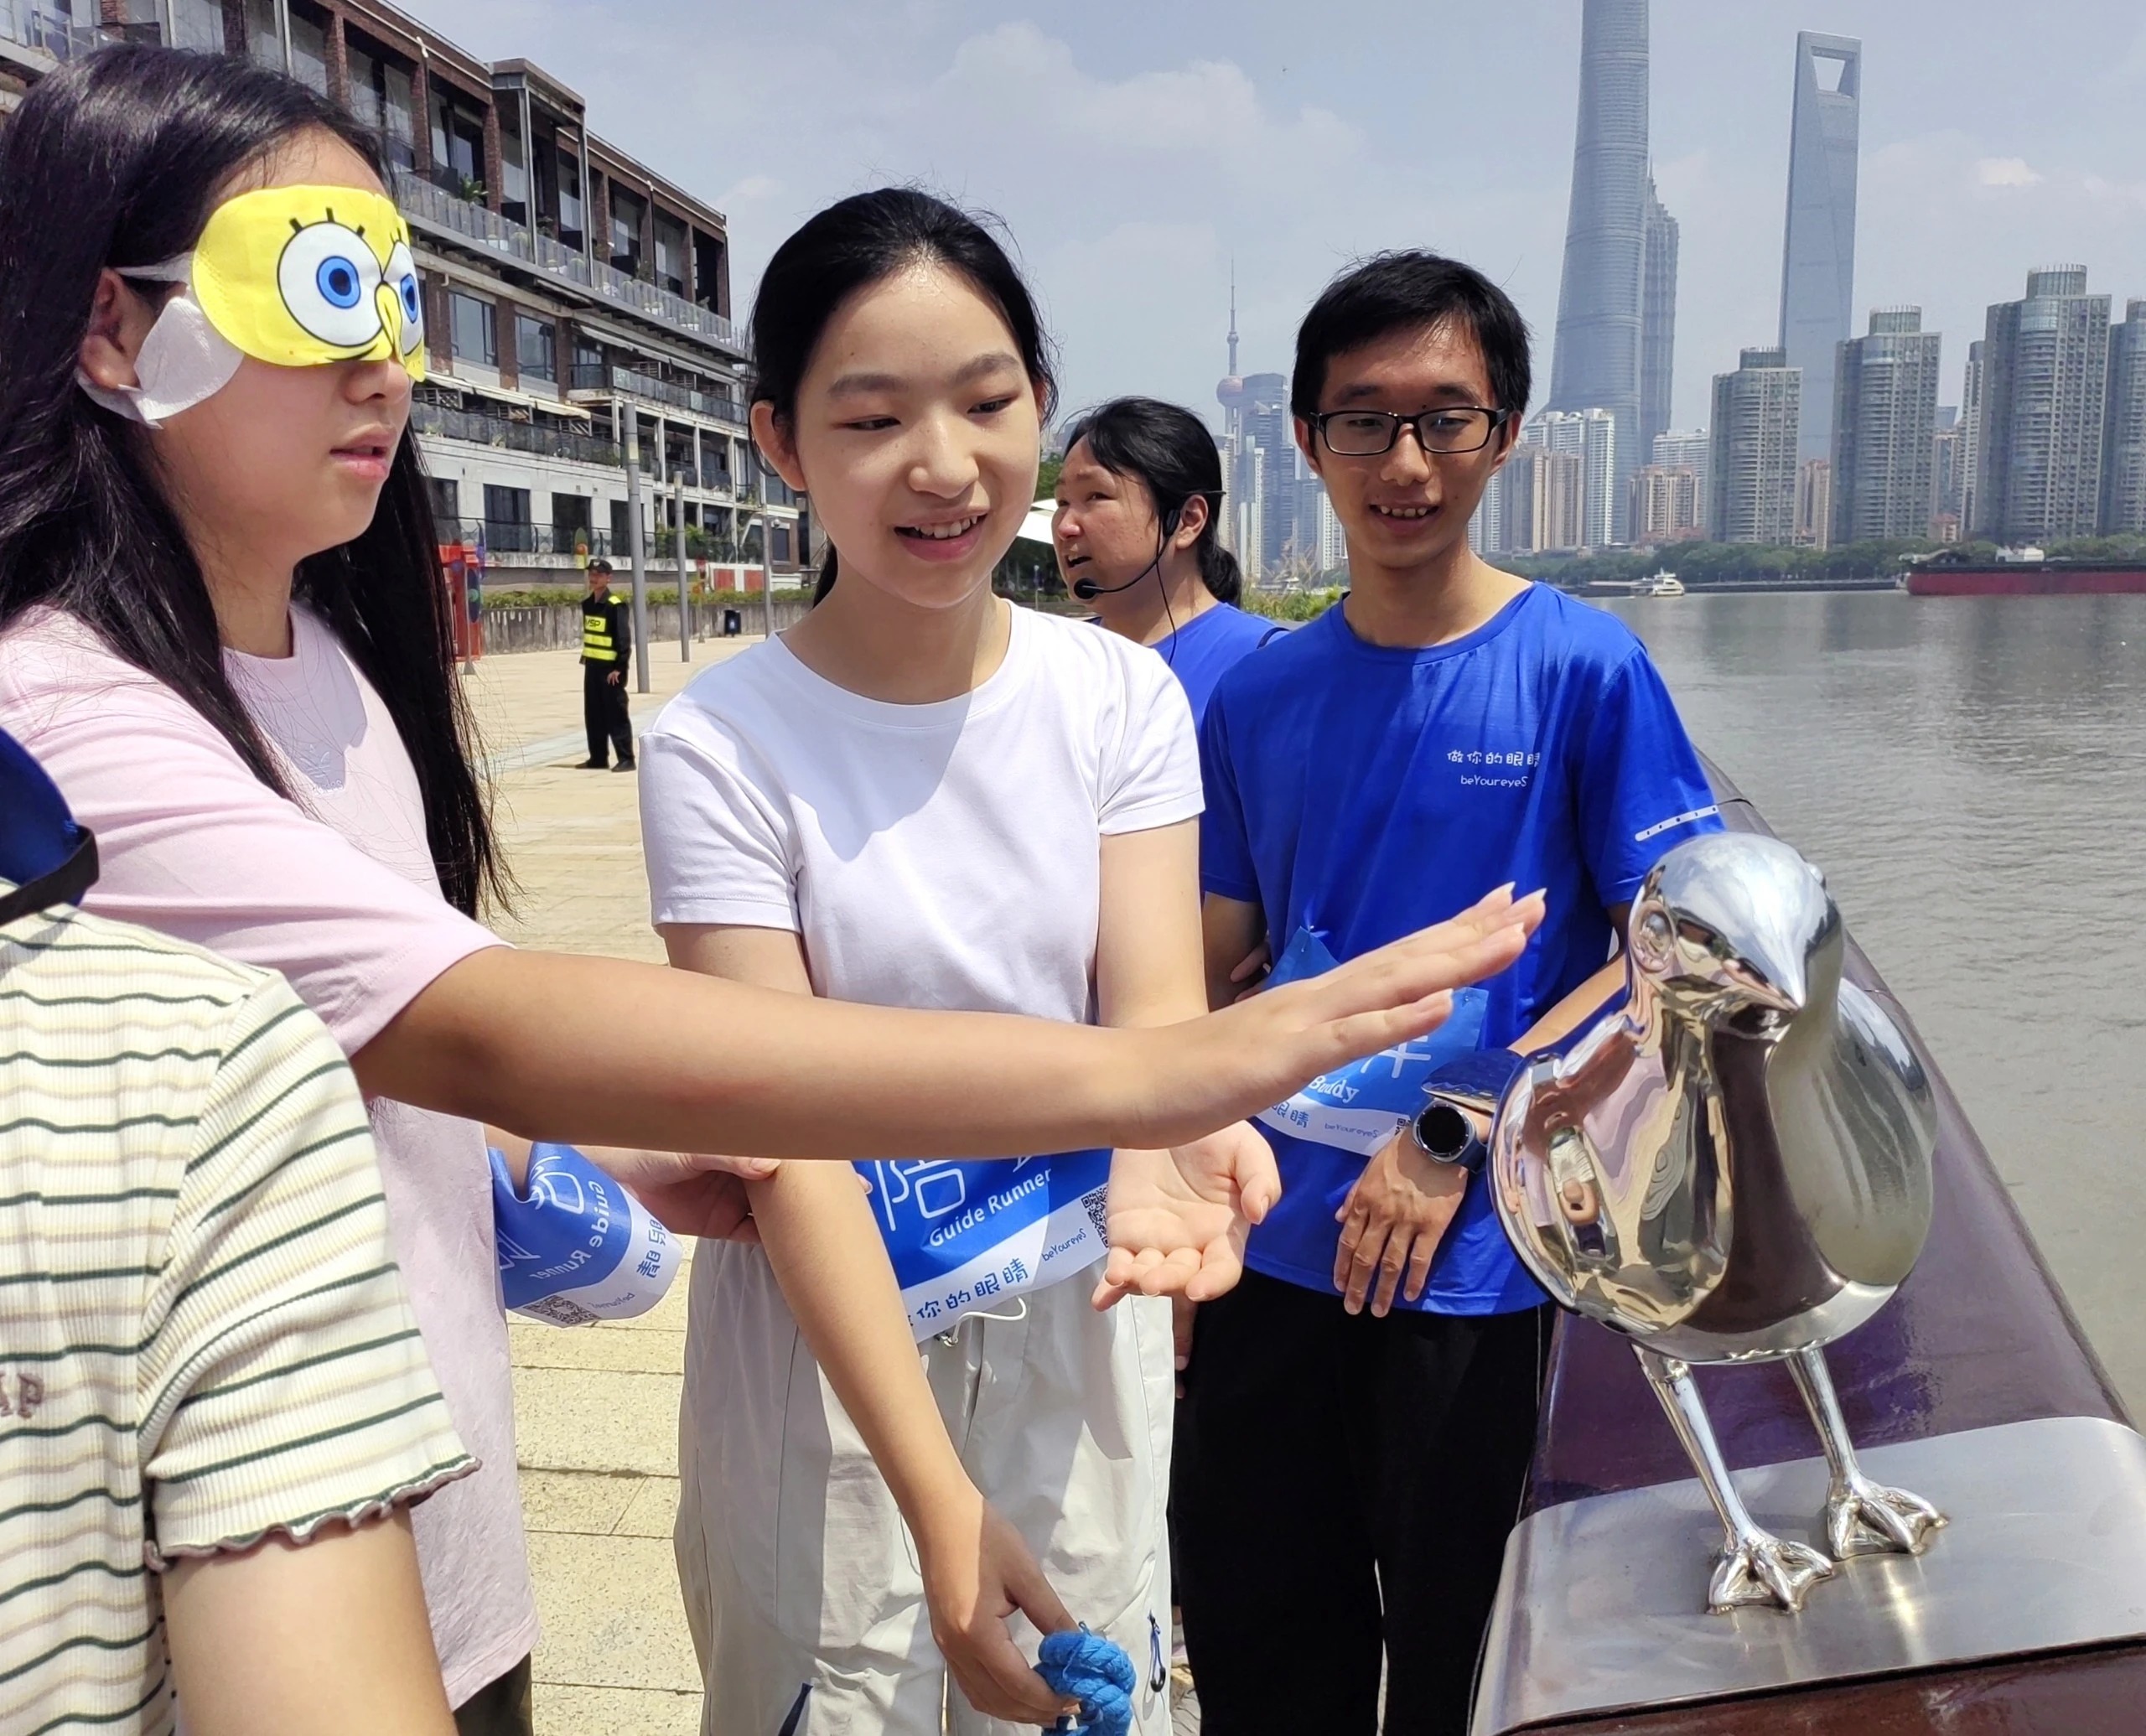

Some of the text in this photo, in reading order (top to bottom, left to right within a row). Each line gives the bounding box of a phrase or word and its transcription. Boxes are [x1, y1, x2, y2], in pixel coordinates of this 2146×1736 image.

[929, 1168, 1053, 1247] Guide Runner
[1041, 1228, 1087, 1262] beYoureyeS
[907, 1257, 1029, 1327] 你的眼睛
